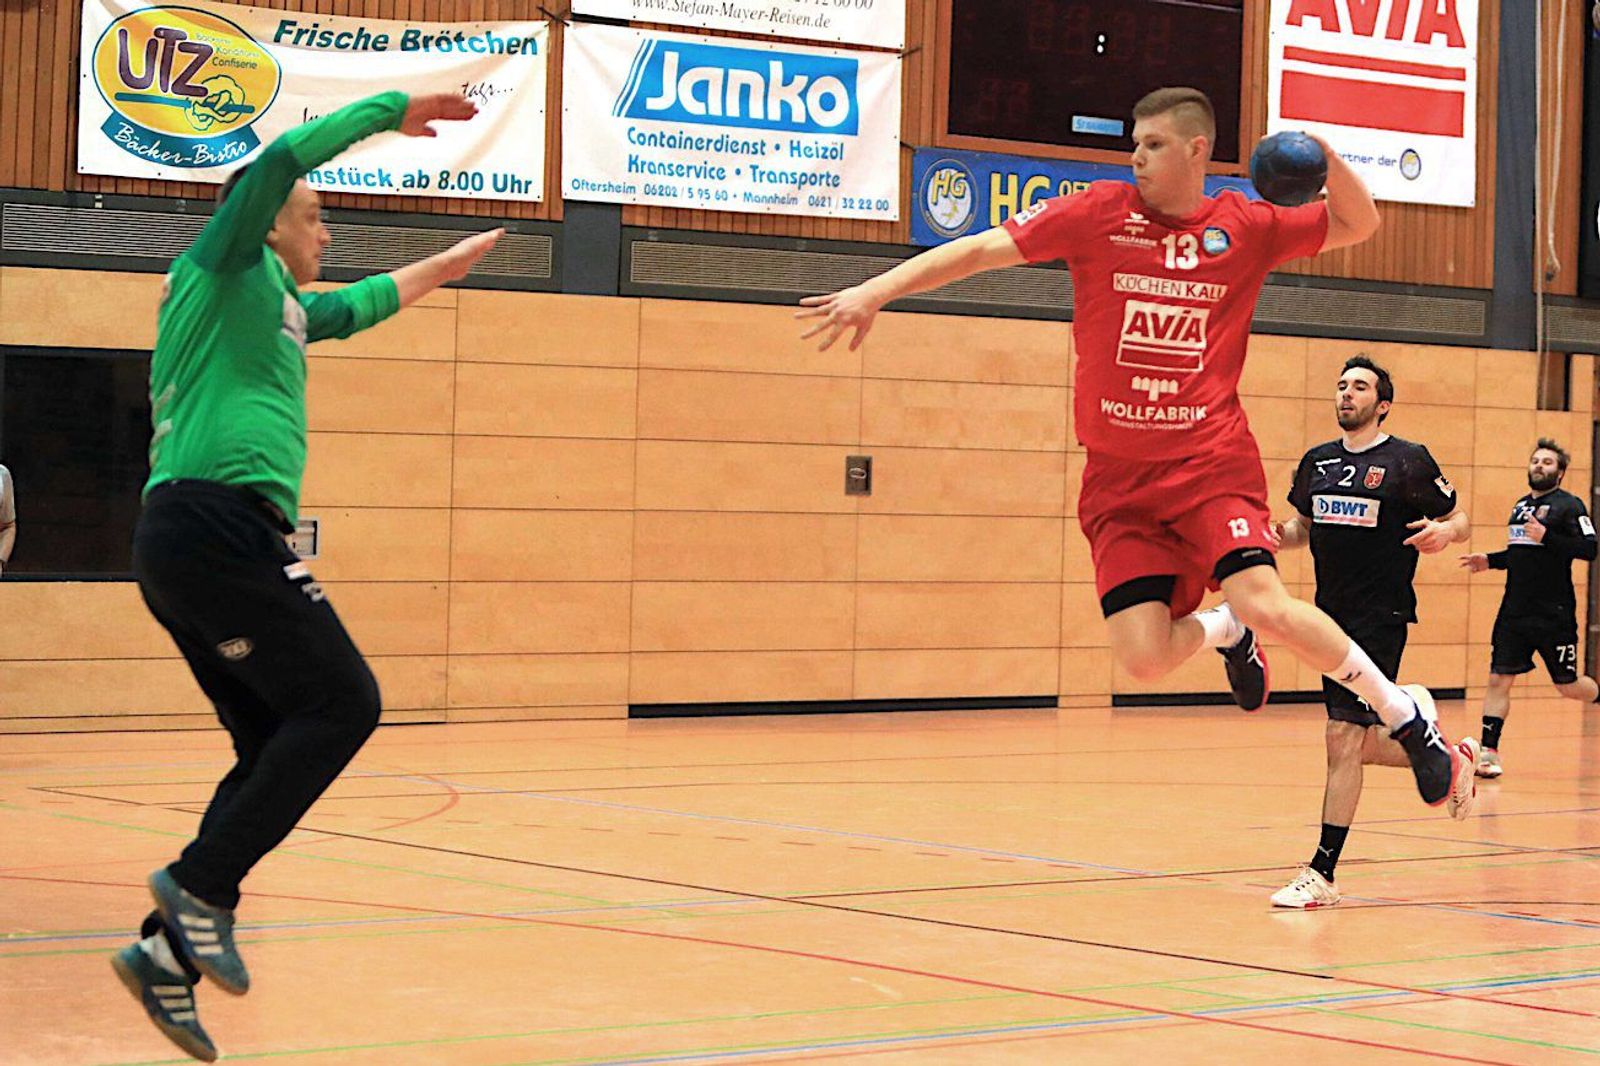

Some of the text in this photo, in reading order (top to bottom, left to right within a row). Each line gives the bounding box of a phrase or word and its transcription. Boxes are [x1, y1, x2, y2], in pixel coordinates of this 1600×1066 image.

[273, 20, 538, 55] Frische Brötchen
[118, 27, 213, 97] UTZ
[212, 57, 257, 69] Confiserie
[645, 51, 850, 127] Janko
[114, 122, 247, 164] Bäcker-Bistro
[627, 126, 844, 160] Containerdienst Heizöl
[627, 154, 841, 190] Kranservice Transporte
[1377, 155, 1397, 167] der
[402, 169, 431, 189] ab
[437, 170, 484, 192] 8.00
[492, 173, 533, 195] Uhr
[571, 178, 636, 194] Oftersheim
[643, 183, 678, 198] 06202
[687, 187, 694, 199] 5
[697, 188, 711, 200] 95
[714, 189, 728, 201] 60
[743, 191, 799, 206] Mannheim
[808, 195, 832, 207] 0621
[841, 197, 855, 209] 32
[858, 199, 873, 210] 22
[875, 200, 890, 211] 00
[932, 170, 966, 205] HG
[1161, 232, 1199, 270] 13
[1115, 276, 1182, 296] KÜCHEN
[1100, 398, 1208, 421] WOLLFABRIK
[1337, 465, 1356, 487] 2
[1331, 500, 1368, 517] BWT
[1227, 517, 1250, 538] 13
[1555, 645, 1576, 663] 73
